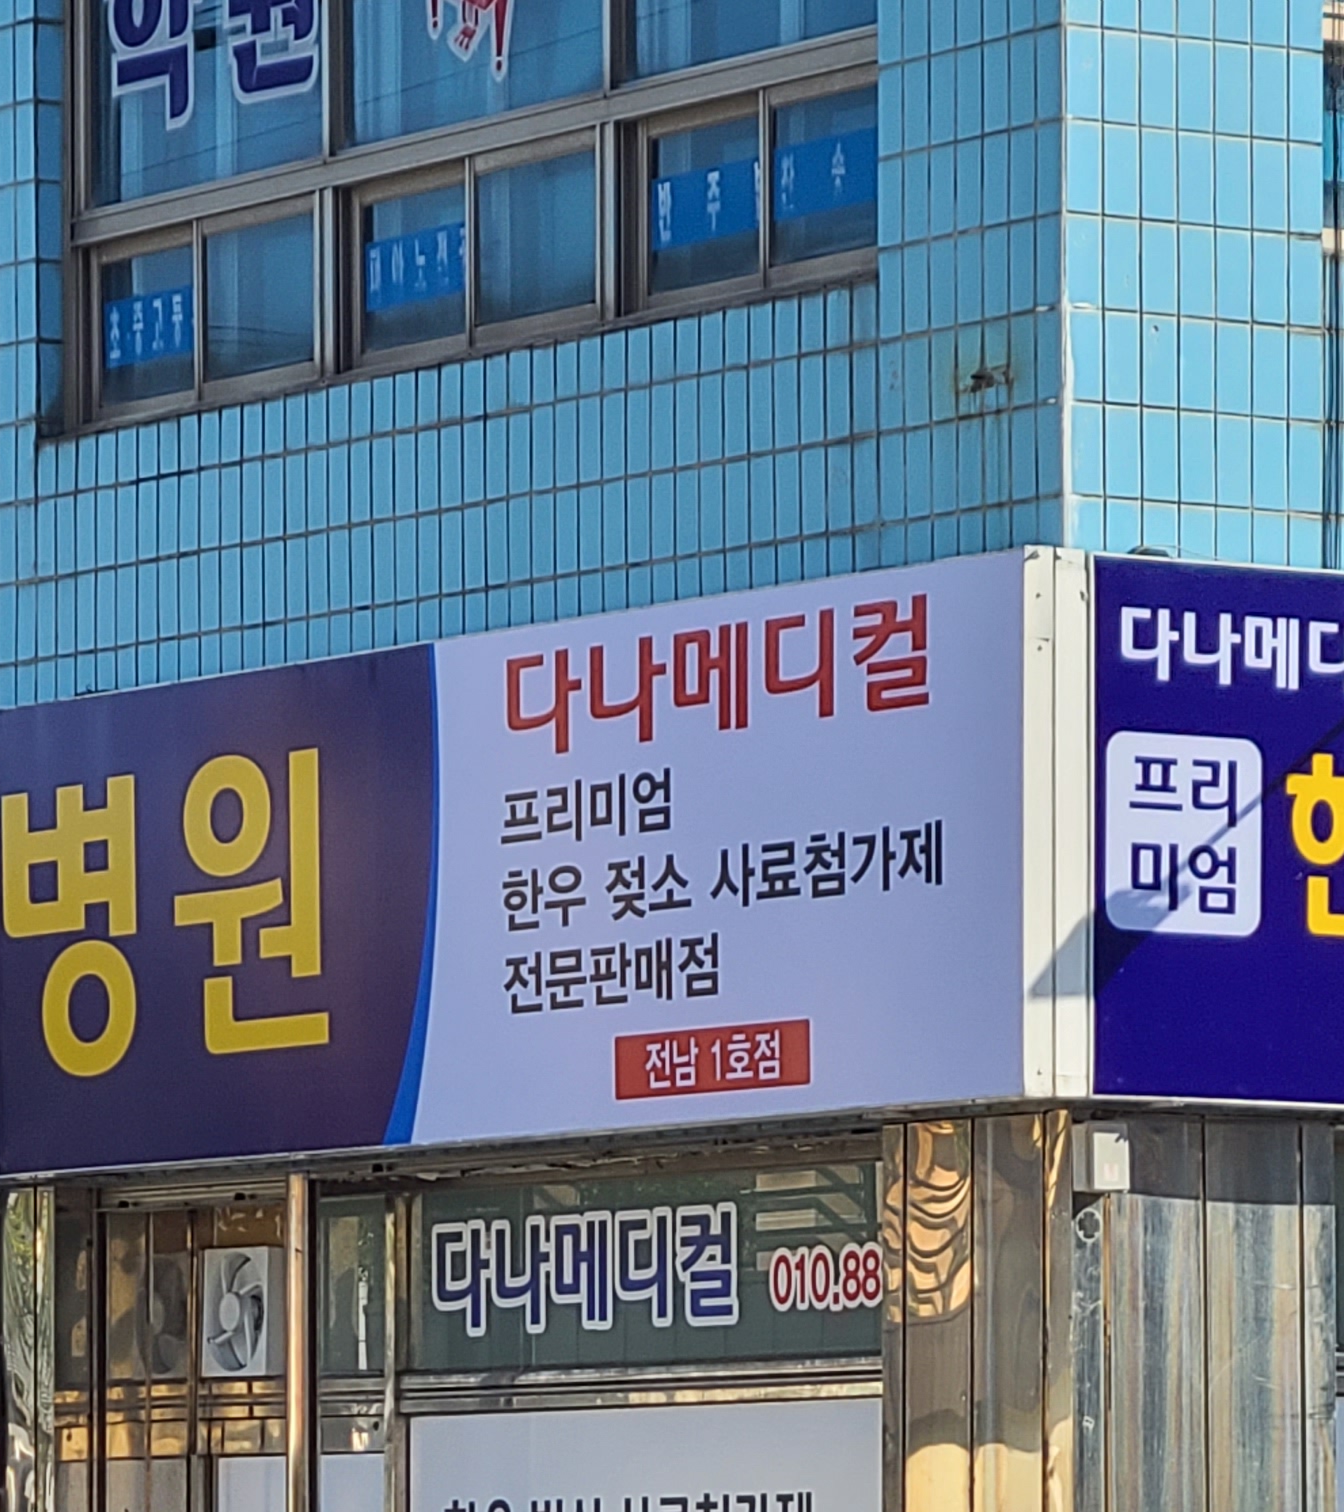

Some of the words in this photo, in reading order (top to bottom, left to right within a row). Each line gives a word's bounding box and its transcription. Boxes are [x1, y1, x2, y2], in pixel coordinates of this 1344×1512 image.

[506, 593, 930, 754] 다나메디컬
[500, 767, 673, 845] 프리미엄
[502, 862, 587, 931] 한우
[605, 853, 692, 921] 젖소
[710, 819, 943, 907] 사료첨가제
[503, 932, 719, 1015] 전문판매점
[645, 1038, 699, 1091] 전남
[710, 1029, 782, 1081] 1호점
[435, 1205, 737, 1333] 다나메디컬
